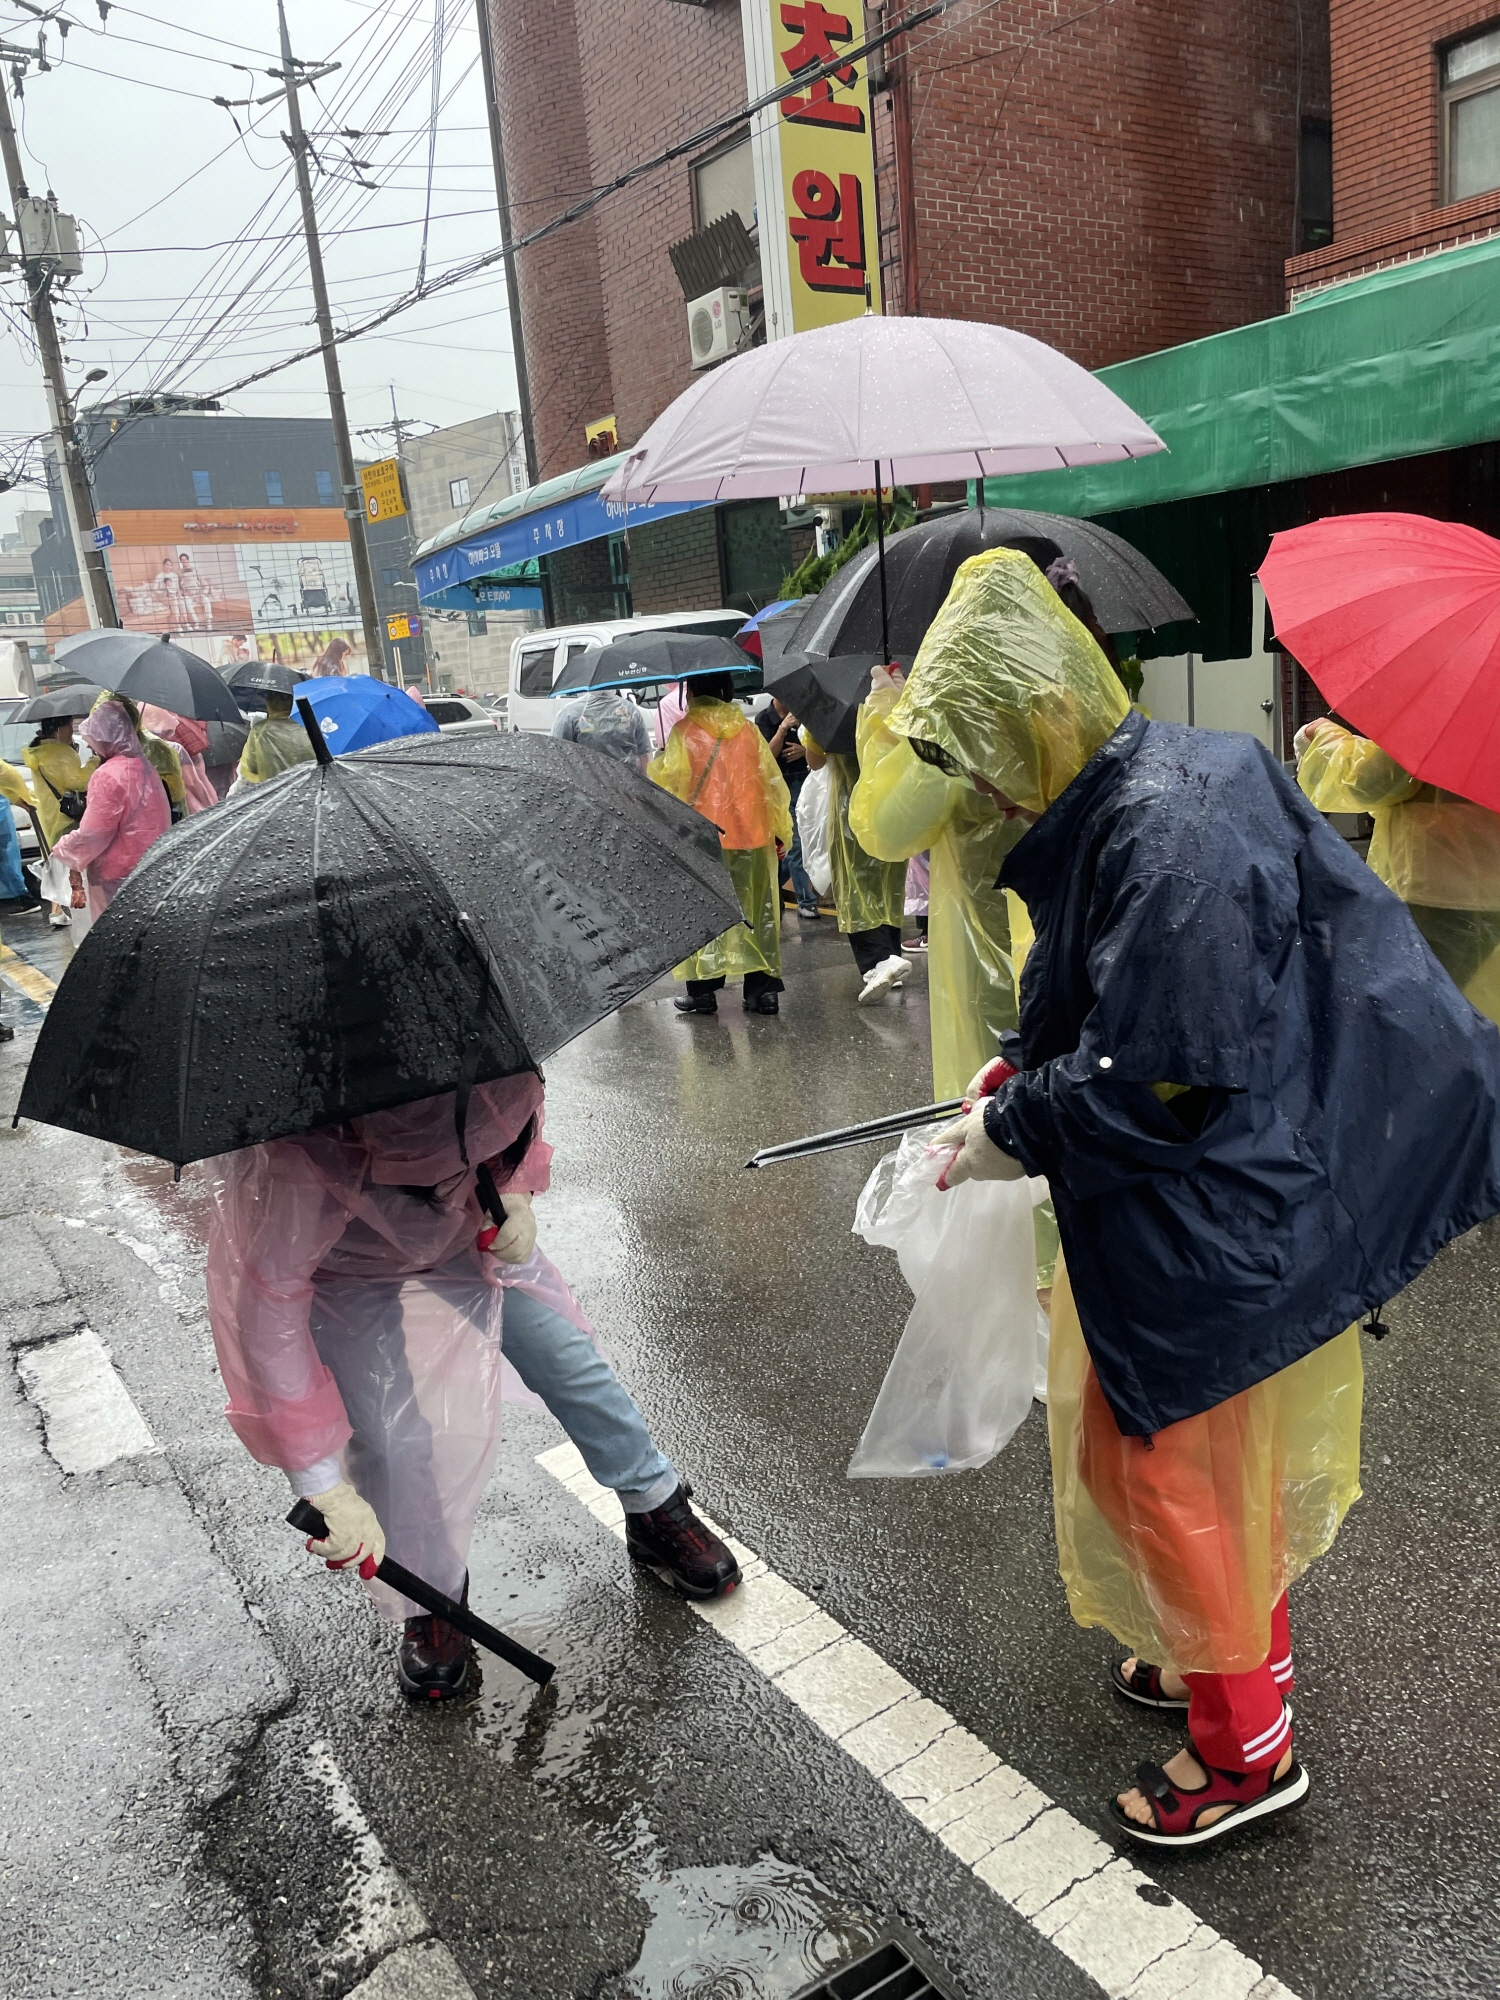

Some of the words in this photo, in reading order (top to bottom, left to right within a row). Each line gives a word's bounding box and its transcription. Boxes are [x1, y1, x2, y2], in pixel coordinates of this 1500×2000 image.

[780, 0, 866, 295] 초원
[714, 319, 722, 329] LG
[533, 518, 565, 545] 주차장
